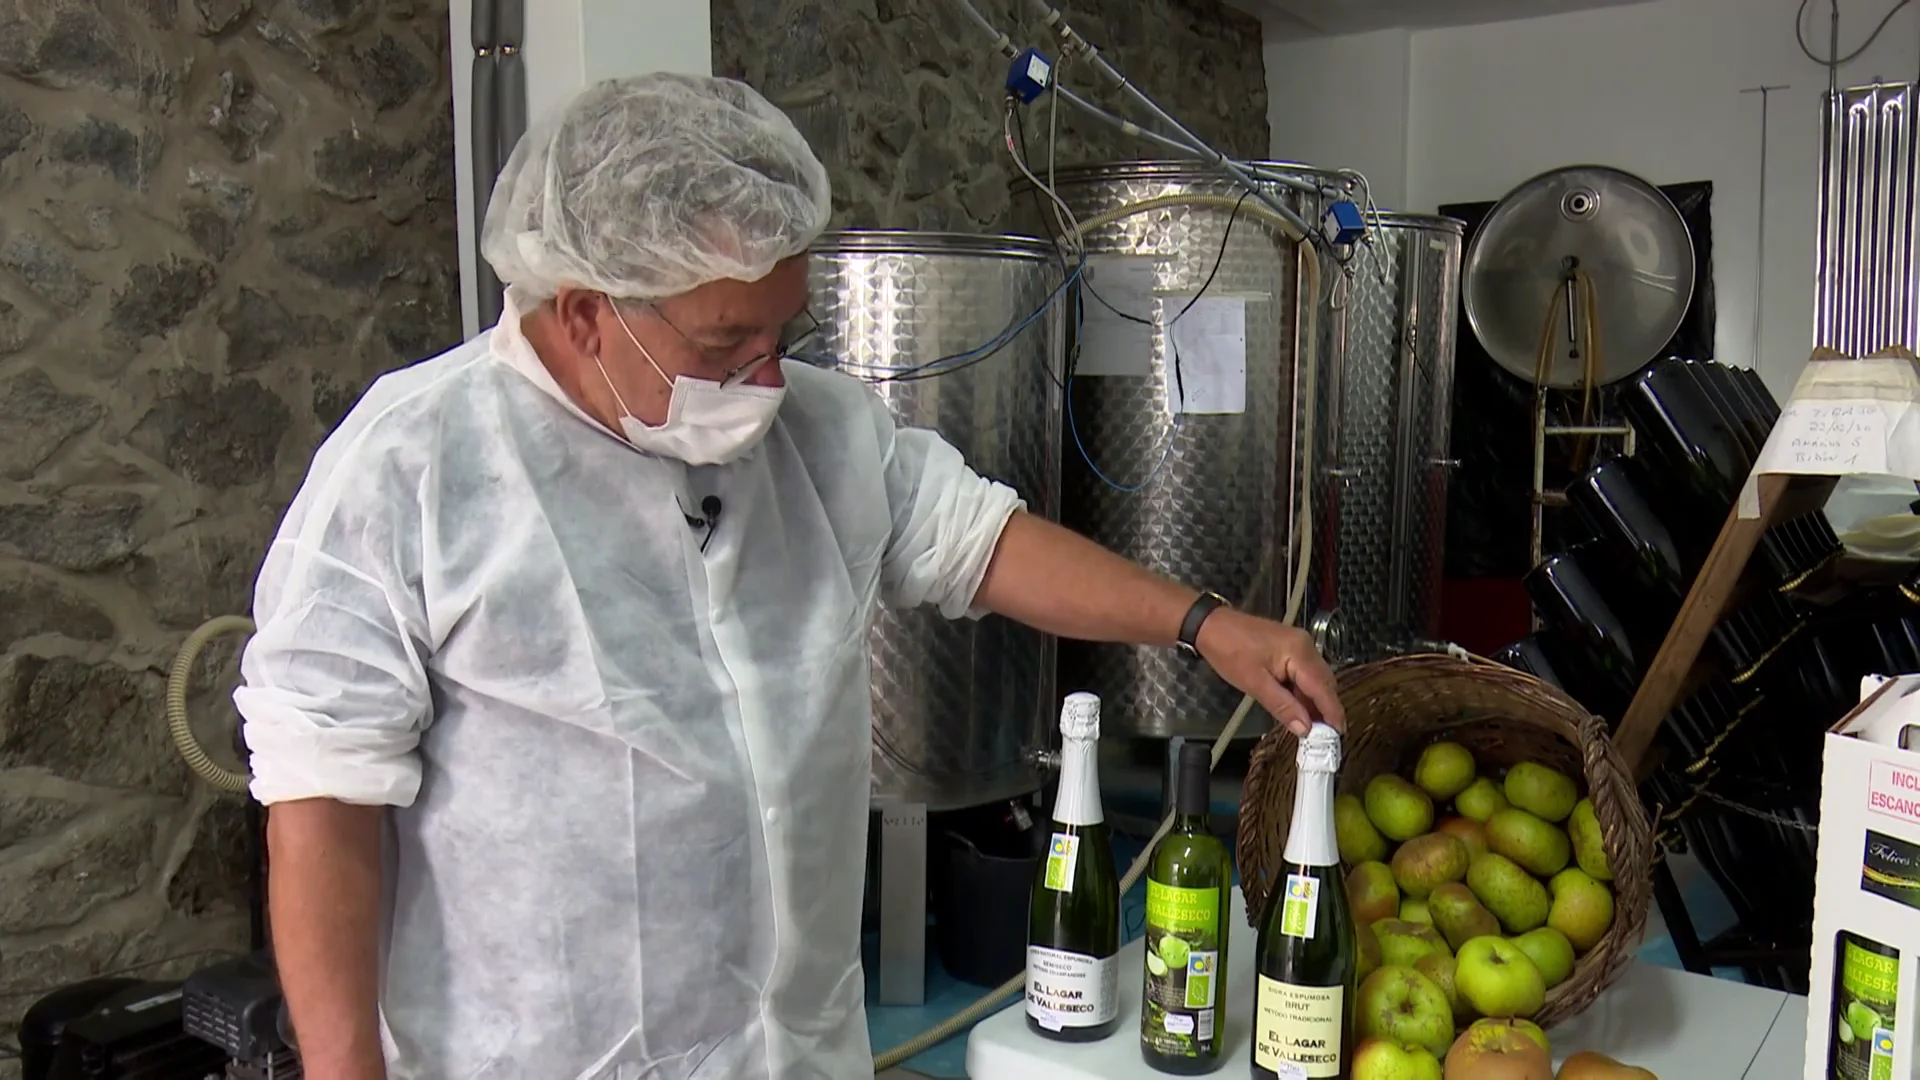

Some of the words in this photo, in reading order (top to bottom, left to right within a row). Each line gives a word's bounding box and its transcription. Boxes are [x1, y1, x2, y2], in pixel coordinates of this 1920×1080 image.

[1160, 888, 1198, 905] LAGAR
[1033, 980, 1045, 994] EL
[1046, 985, 1083, 999] LAGAR
[1289, 991, 1331, 1001] ESPUMOSA
[1036, 997, 1094, 1013] VALLESECO
[1285, 1001, 1311, 1012] BRUT
[1289, 1014, 1333, 1024] TRADICIONAL
[1268, 1029, 1281, 1044] EL
[1285, 1035, 1327, 1049] LAGAR
[1258, 1042, 1270, 1055] DE
[1272, 1046, 1337, 1063] VALLESECO
